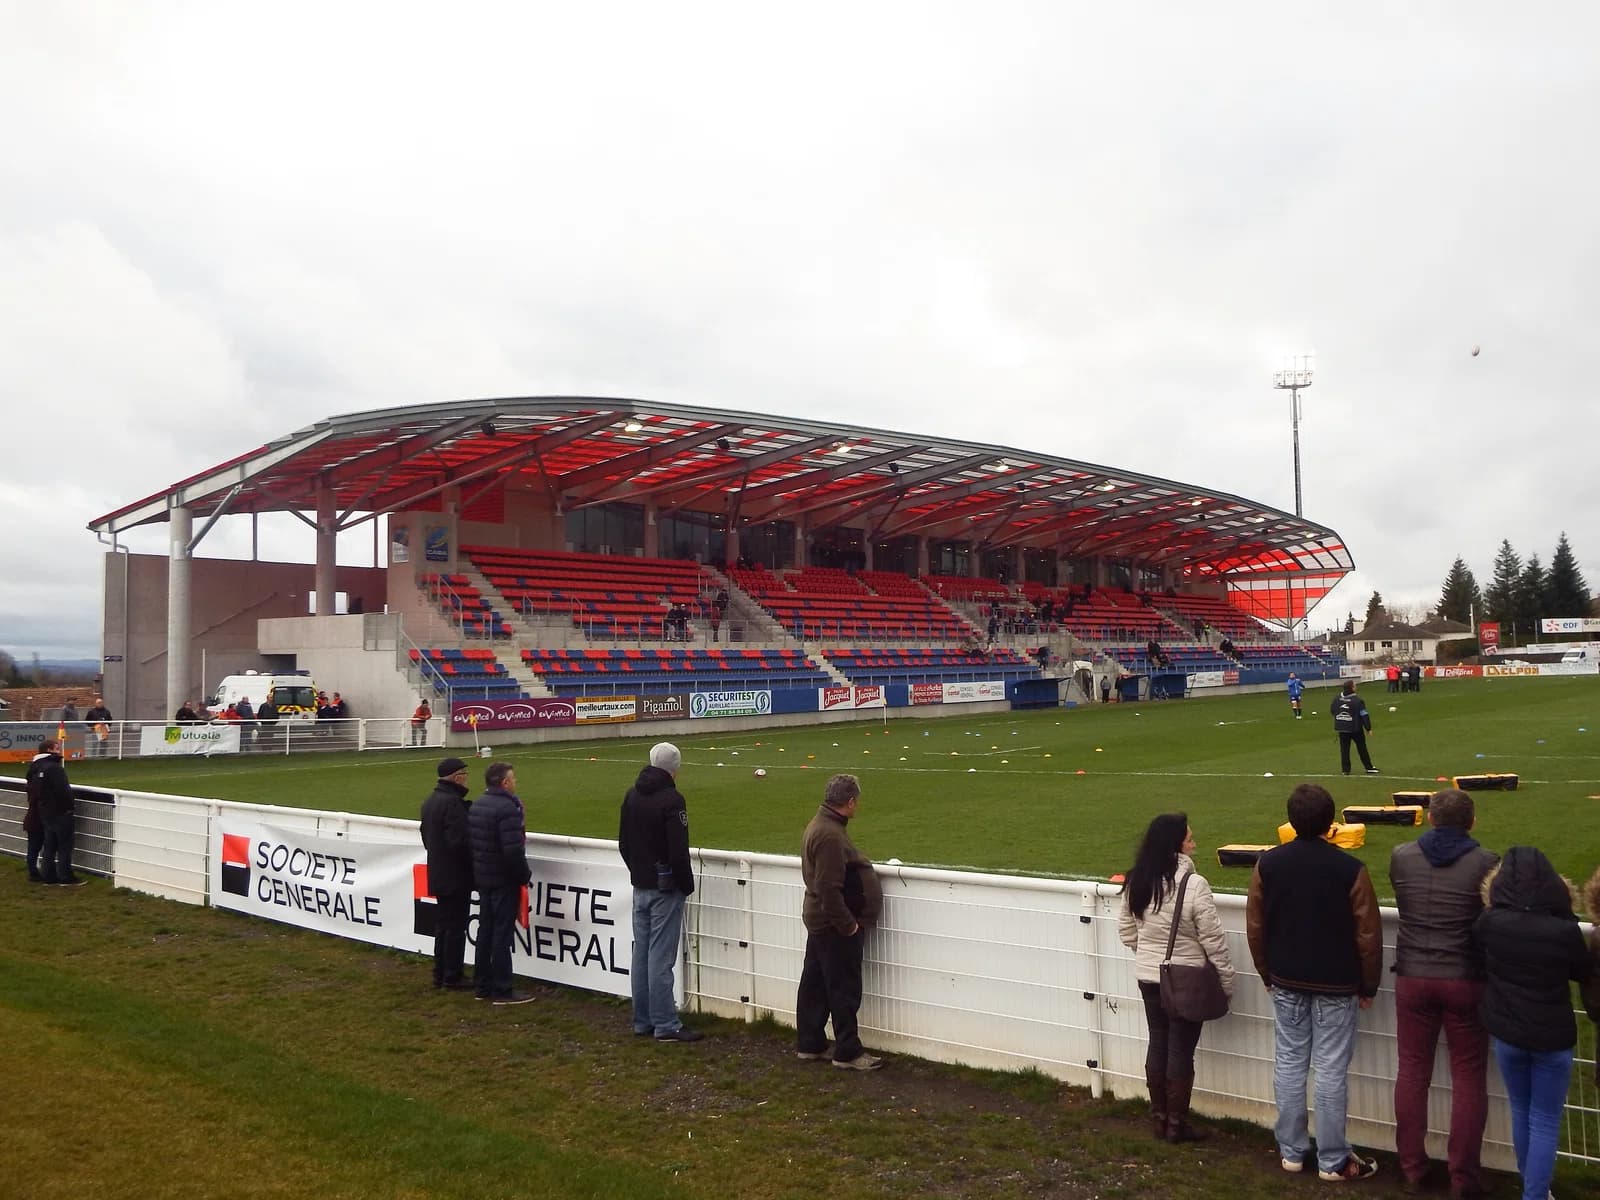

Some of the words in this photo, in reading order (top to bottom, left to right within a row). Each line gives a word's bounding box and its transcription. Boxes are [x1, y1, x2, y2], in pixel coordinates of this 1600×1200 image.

[577, 703, 634, 712] meilleurtaux.com
[708, 691, 756, 702] SECURITEST
[256, 841, 356, 885] SOCIETE
[257, 874, 382, 927] GENERALE
[466, 913, 635, 975] NERAL
